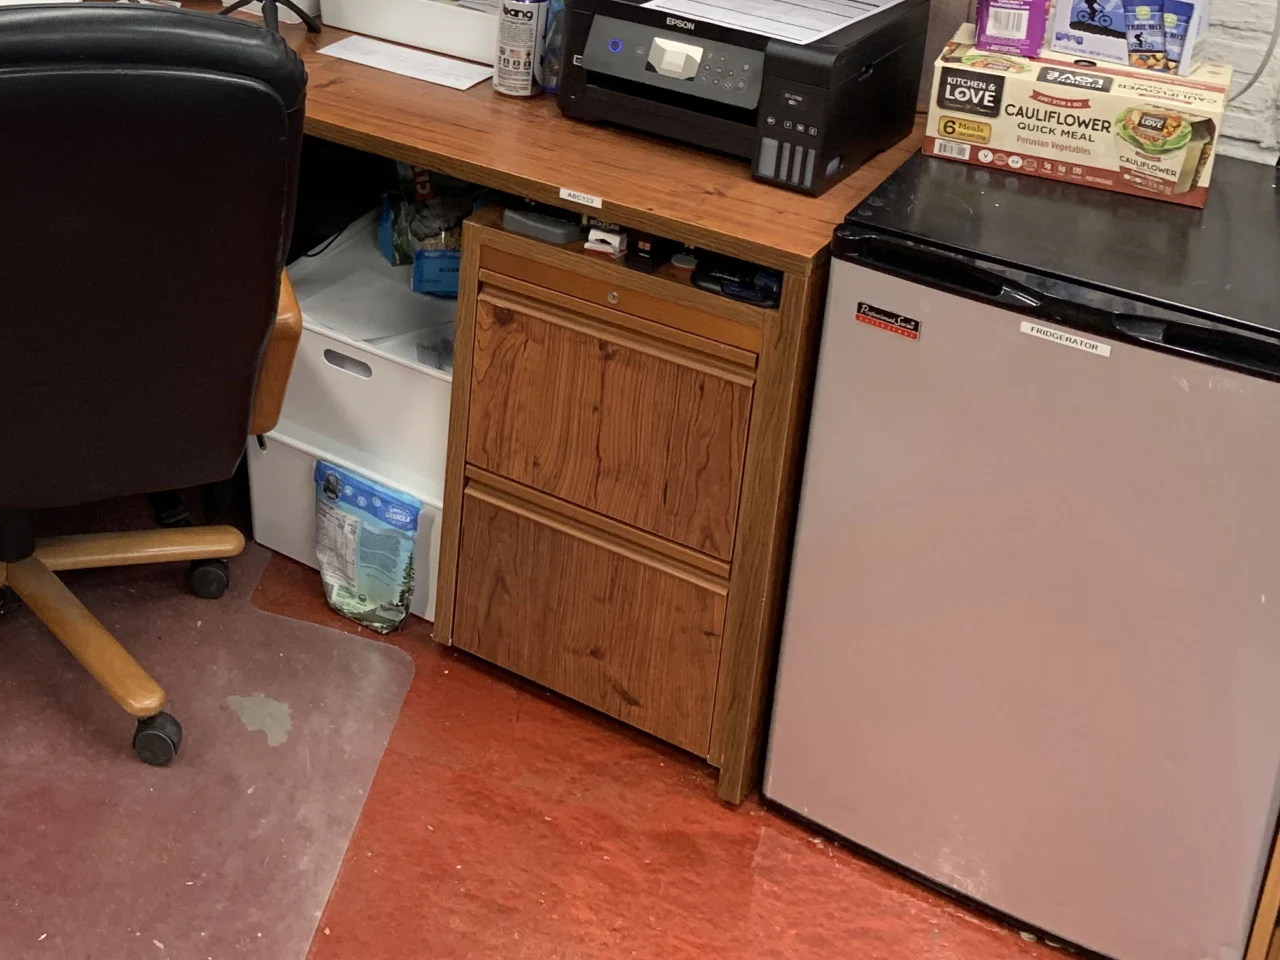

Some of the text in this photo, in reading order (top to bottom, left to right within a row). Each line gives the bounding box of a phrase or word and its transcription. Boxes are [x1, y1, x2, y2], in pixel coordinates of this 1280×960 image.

[503, 4, 534, 21] bang
[666, 18, 694, 30] EPSON
[947, 76, 986, 89] KITCHEN
[1045, 70, 1104, 86] LOVE
[944, 85, 996, 106] LOVE
[1004, 104, 1112, 134] CAULIFLOWER
[1140, 118, 1163, 130] LOVE
[942, 120, 984, 135] 6 Meals
[1018, 122, 1096, 143] QUICK MEAL
[1017, 136, 1091, 156] Peruvian Vegetables
[1119, 155, 1178, 178] CAULIFLOWER
[567, 192, 594, 205] ABC123
[1030, 326, 1098, 352] FRIDGERATOR
[385, 510, 411, 522] GRANOLA
